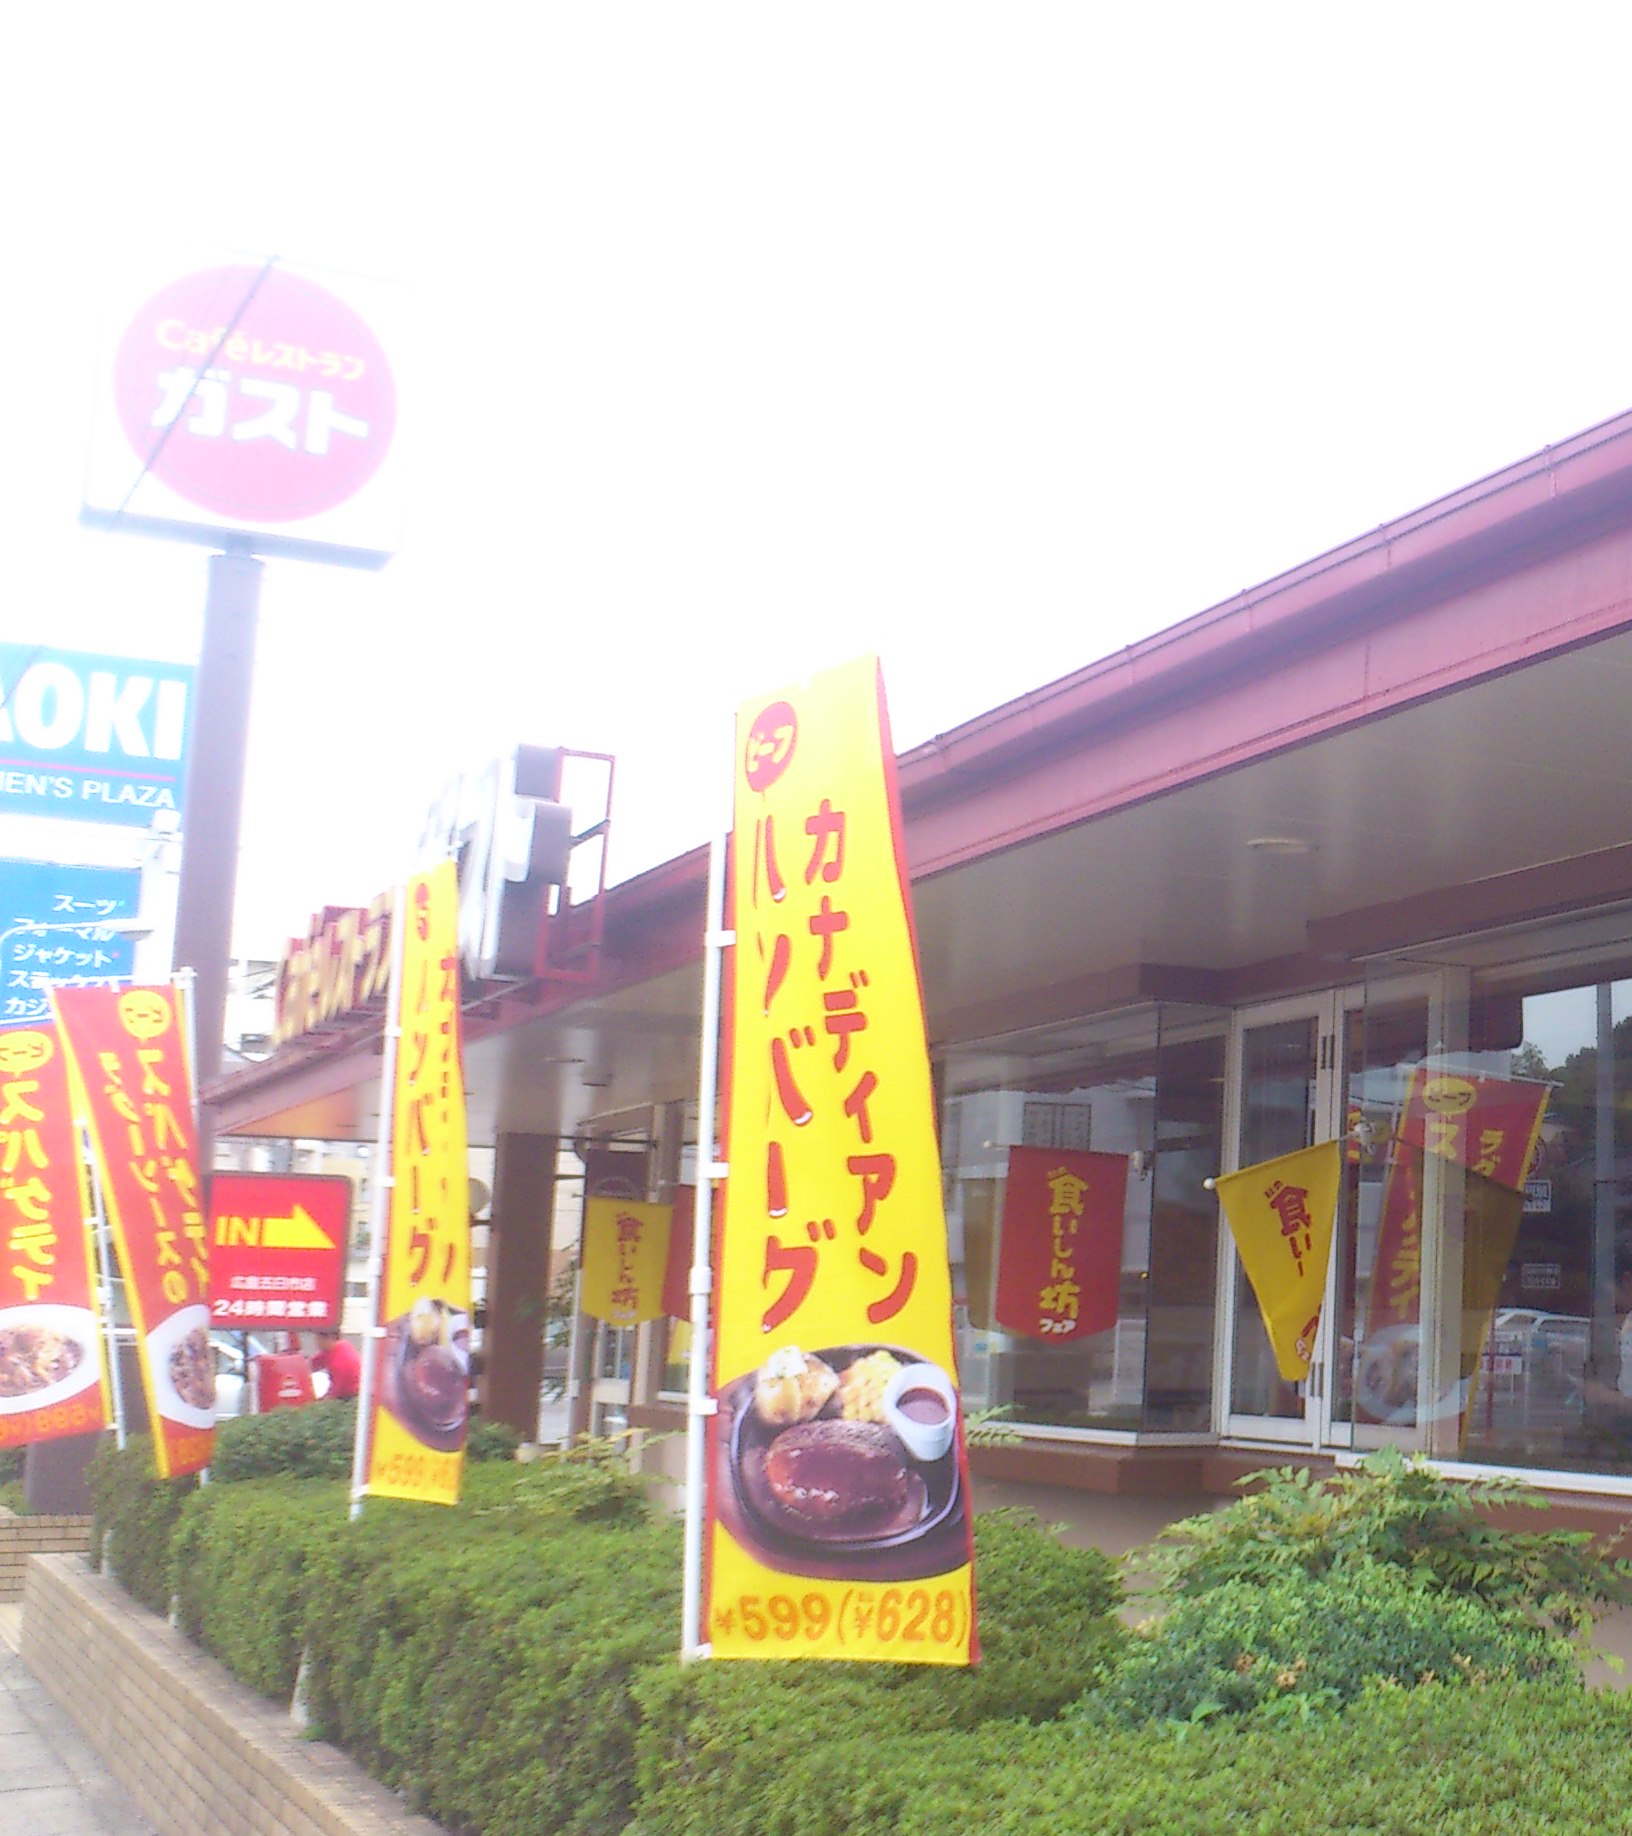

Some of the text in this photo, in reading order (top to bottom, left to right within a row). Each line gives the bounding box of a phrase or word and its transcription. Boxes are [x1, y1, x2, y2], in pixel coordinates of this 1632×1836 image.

[150, 366, 369, 456] ガスト
[0, 662, 187, 760] OKI
[0, 771, 175, 809] EN'S PLAZA
[52, 893, 117, 916] スーツ
[13, 943, 112, 968] ジャケット
[804, 798, 918, 1325] カナディアン
[214, 1216, 260, 1247] IN
[1039, 1166, 1089, 1320] 食いしん坊
[1039, 1317, 1077, 1334] フェア
